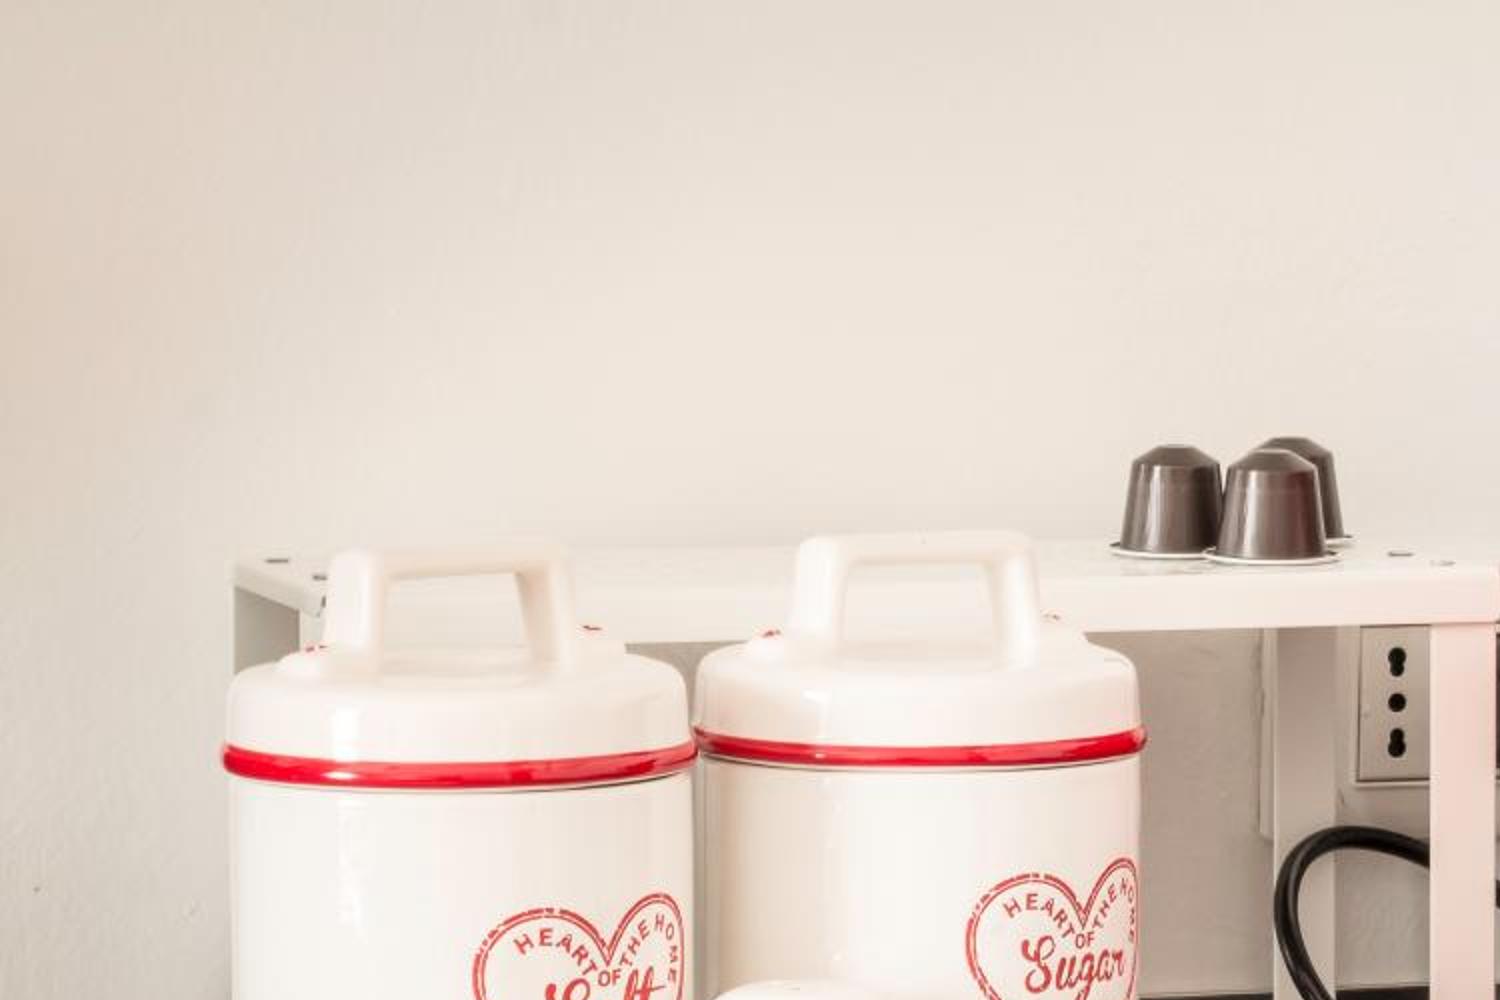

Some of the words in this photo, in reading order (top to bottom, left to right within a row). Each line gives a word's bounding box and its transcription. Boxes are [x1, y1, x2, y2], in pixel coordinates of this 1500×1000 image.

[1003, 893, 1075, 938] HEART
[1075, 931, 1095, 949] OF
[1092, 884, 1117, 929] THE
[513, 928, 598, 976] HEART
[598, 969, 621, 987] OF
[619, 919, 651, 967] THE
